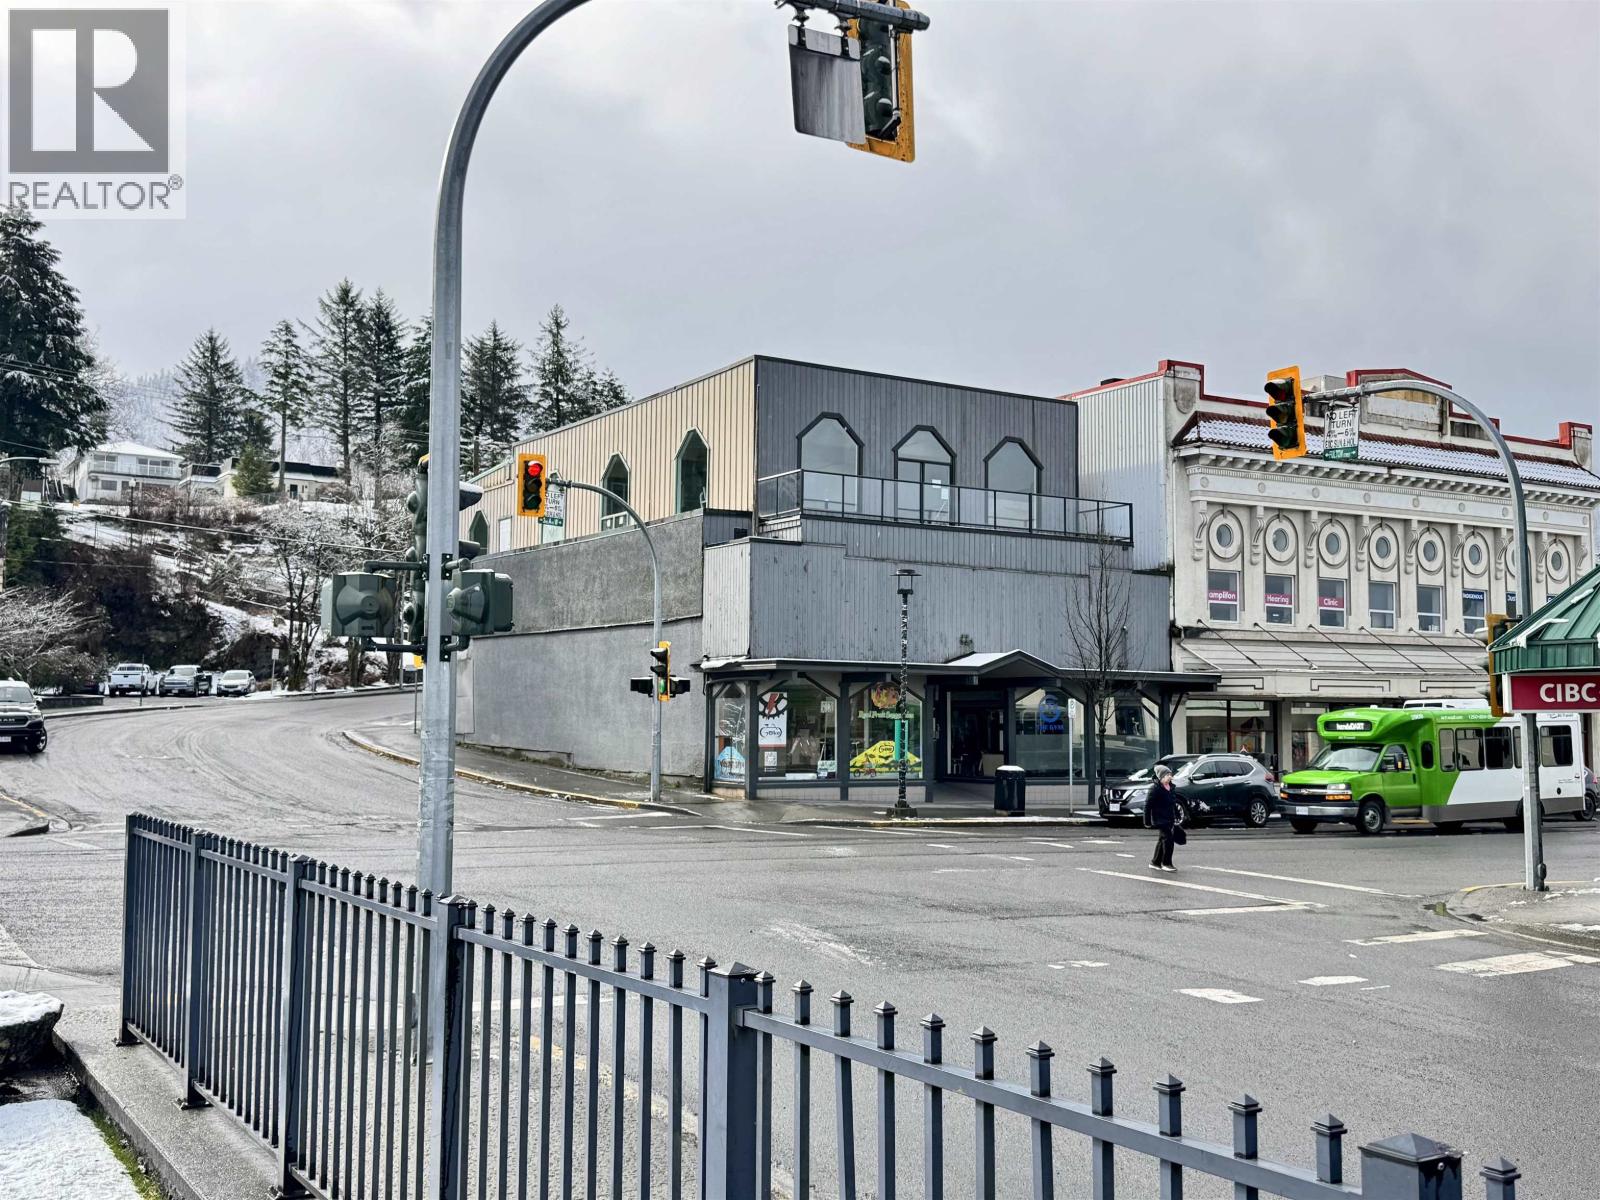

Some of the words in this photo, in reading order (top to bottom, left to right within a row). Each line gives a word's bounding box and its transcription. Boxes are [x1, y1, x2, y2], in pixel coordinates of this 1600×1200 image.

[1339, 410, 1357, 419] LEFT
[1331, 420, 1352, 428] TURN
[1209, 591, 1236, 601] amplifon
[1267, 595, 1289, 605] Hearing
[1323, 598, 1338, 607] Clinic
[1539, 682, 1598, 703] CIBC
